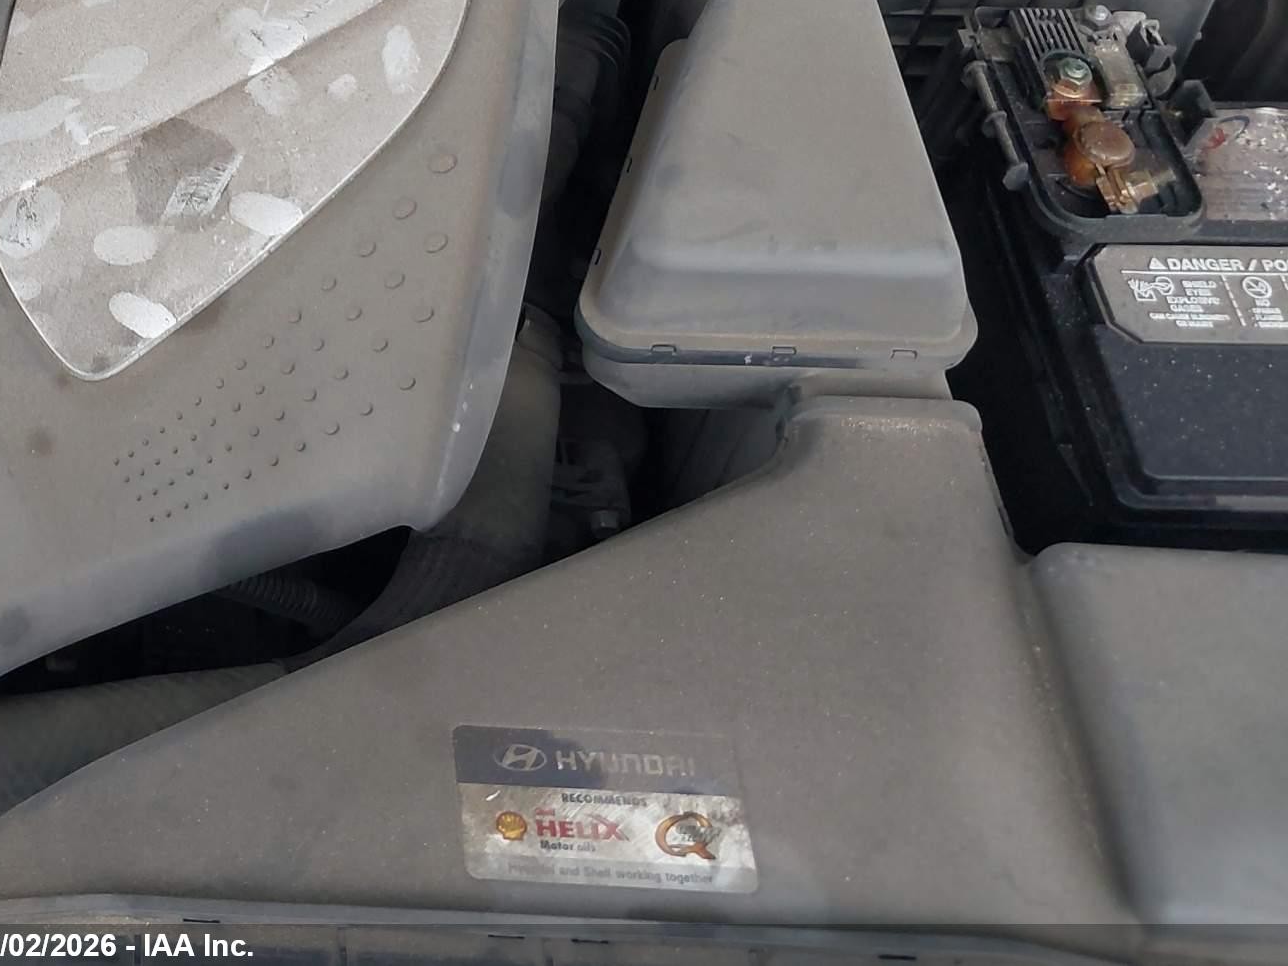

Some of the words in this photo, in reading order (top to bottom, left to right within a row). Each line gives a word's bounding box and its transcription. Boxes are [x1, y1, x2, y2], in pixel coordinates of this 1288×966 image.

[1167, 258, 1245, 271] DANGER
[1262, 259, 1288, 271] PO
[555, 750, 696, 777] HYUNDAI
